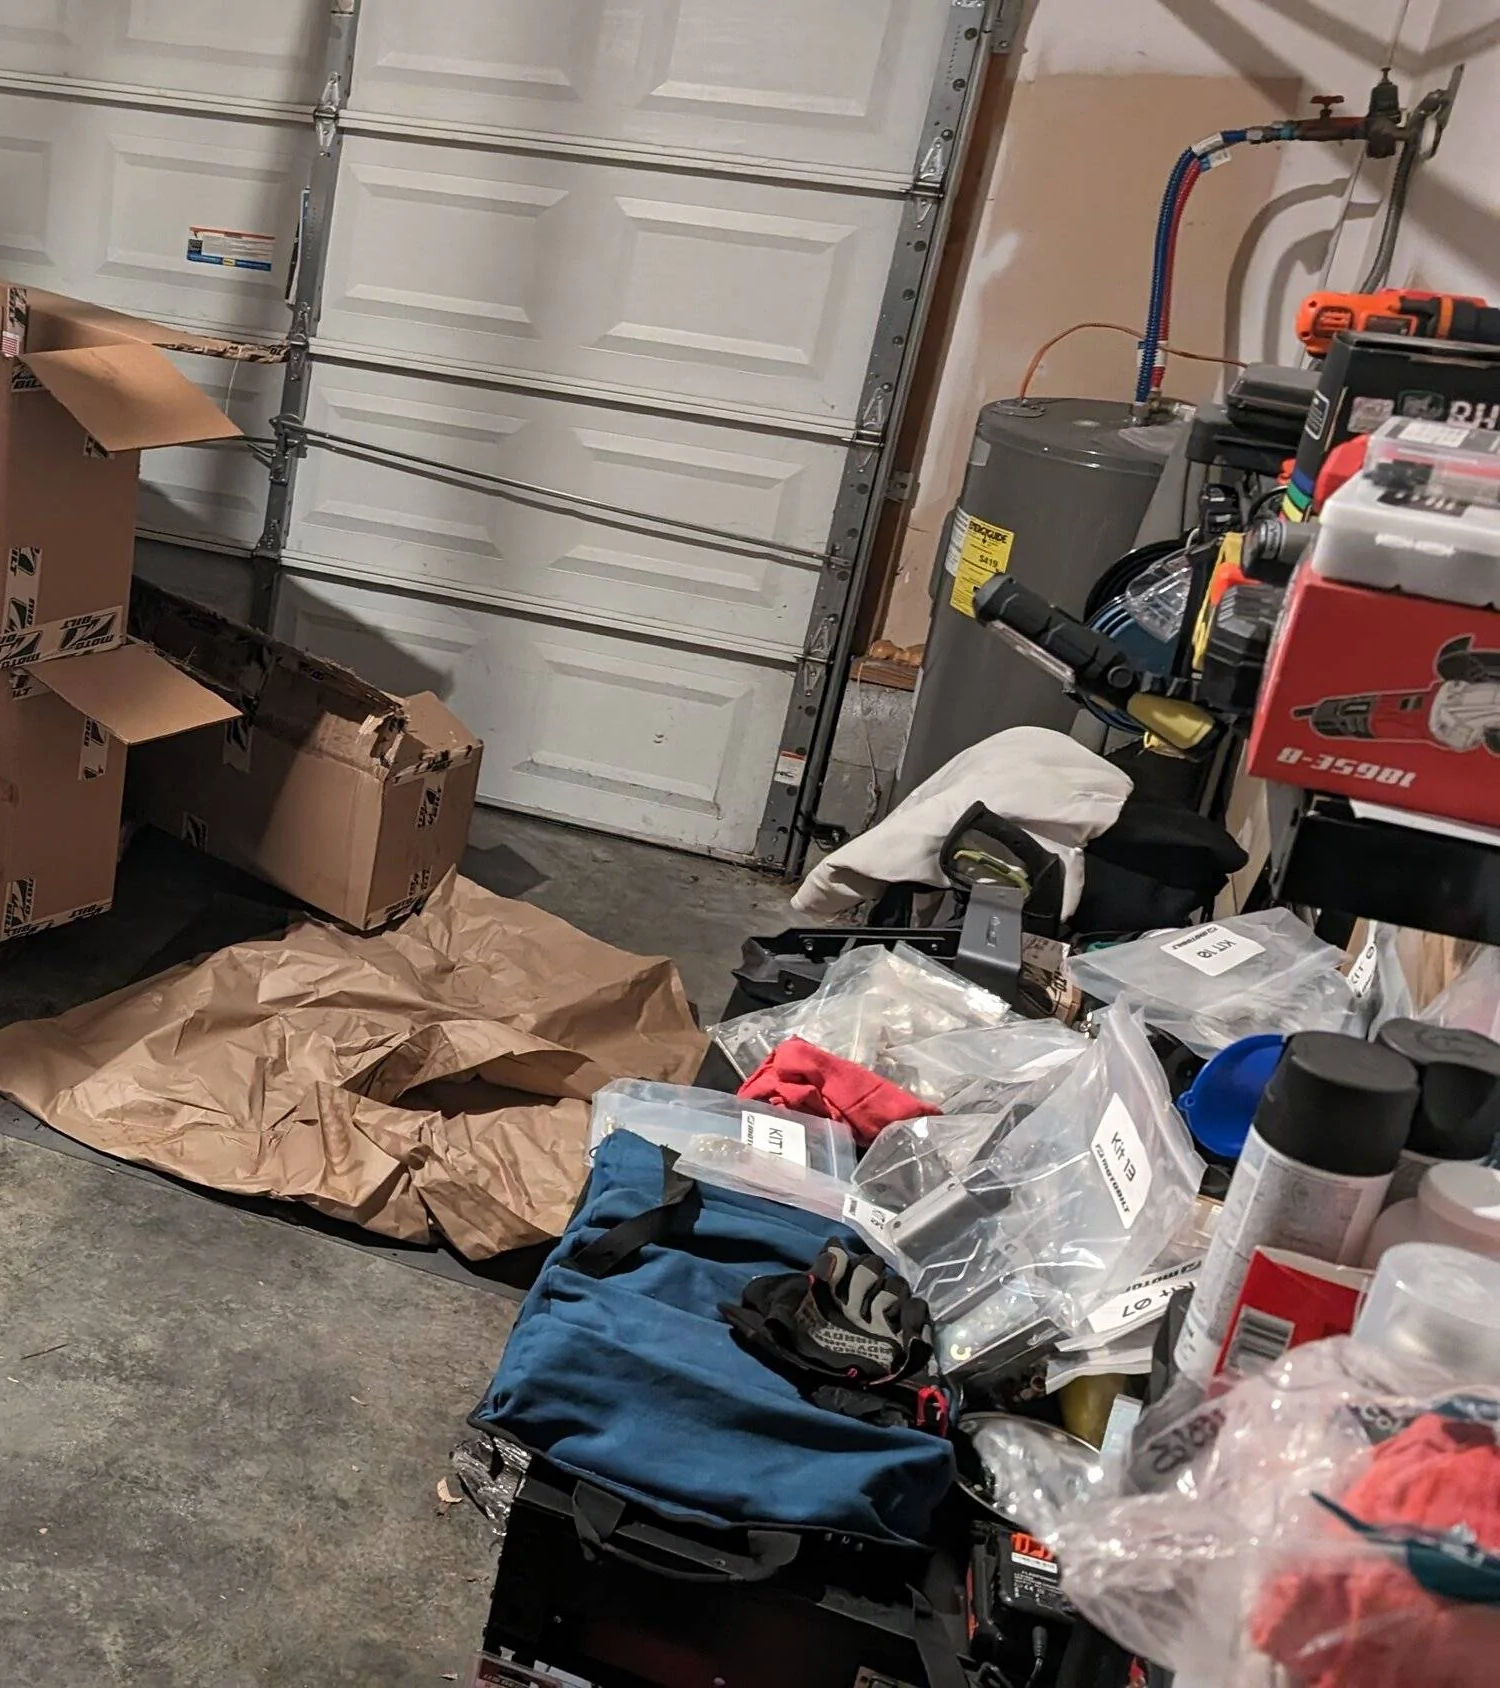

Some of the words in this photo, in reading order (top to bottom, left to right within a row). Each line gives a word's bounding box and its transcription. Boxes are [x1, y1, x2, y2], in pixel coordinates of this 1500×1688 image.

[12, 379, 43, 390] BIL
[60, 615, 95, 630] BILT
[75, 634, 115, 650] MOTO
[0, 653, 41, 669] MOTO
[1212, 939, 1236, 952] KIT
[768, 1127, 783, 1149] KIT
[1110, 1131, 1125, 1161] Kit
[1122, 1157, 1137, 1183] 13
